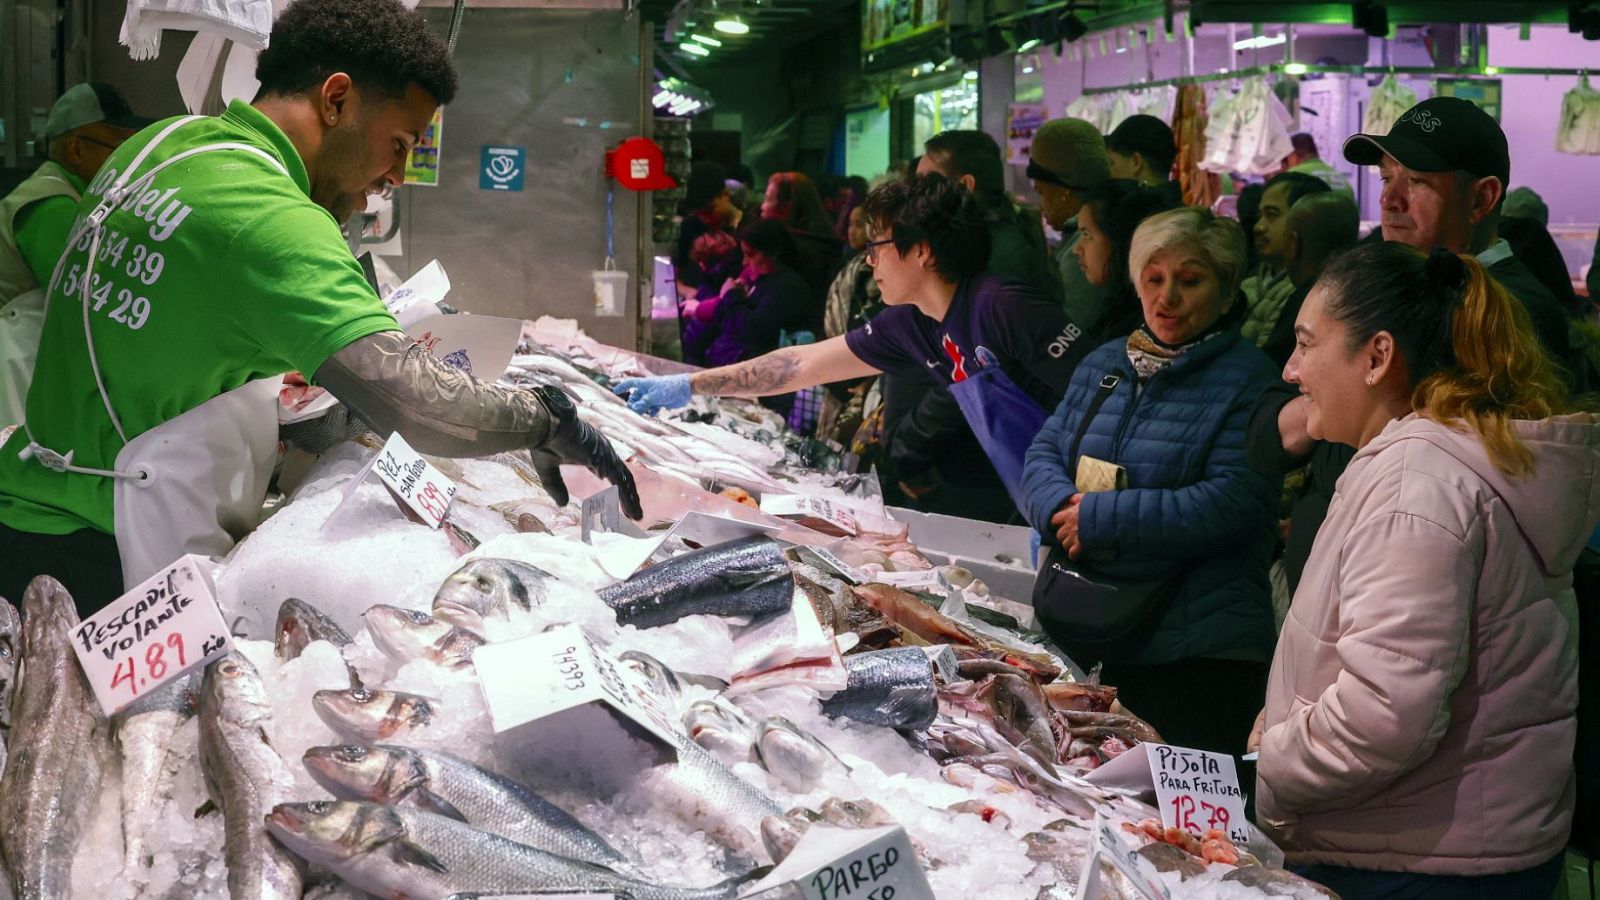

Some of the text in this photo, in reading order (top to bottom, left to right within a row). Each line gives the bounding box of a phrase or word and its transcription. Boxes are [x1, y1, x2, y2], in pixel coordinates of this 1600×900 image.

[126, 244, 165, 285] 39
[108, 288, 150, 330] 29
[1048, 323, 1081, 358] QNB
[377, 451, 401, 482] PEZ
[110, 632, 186, 695] 4.89
[552, 646, 585, 691] 94393
[1160, 771, 1191, 791] PARA
